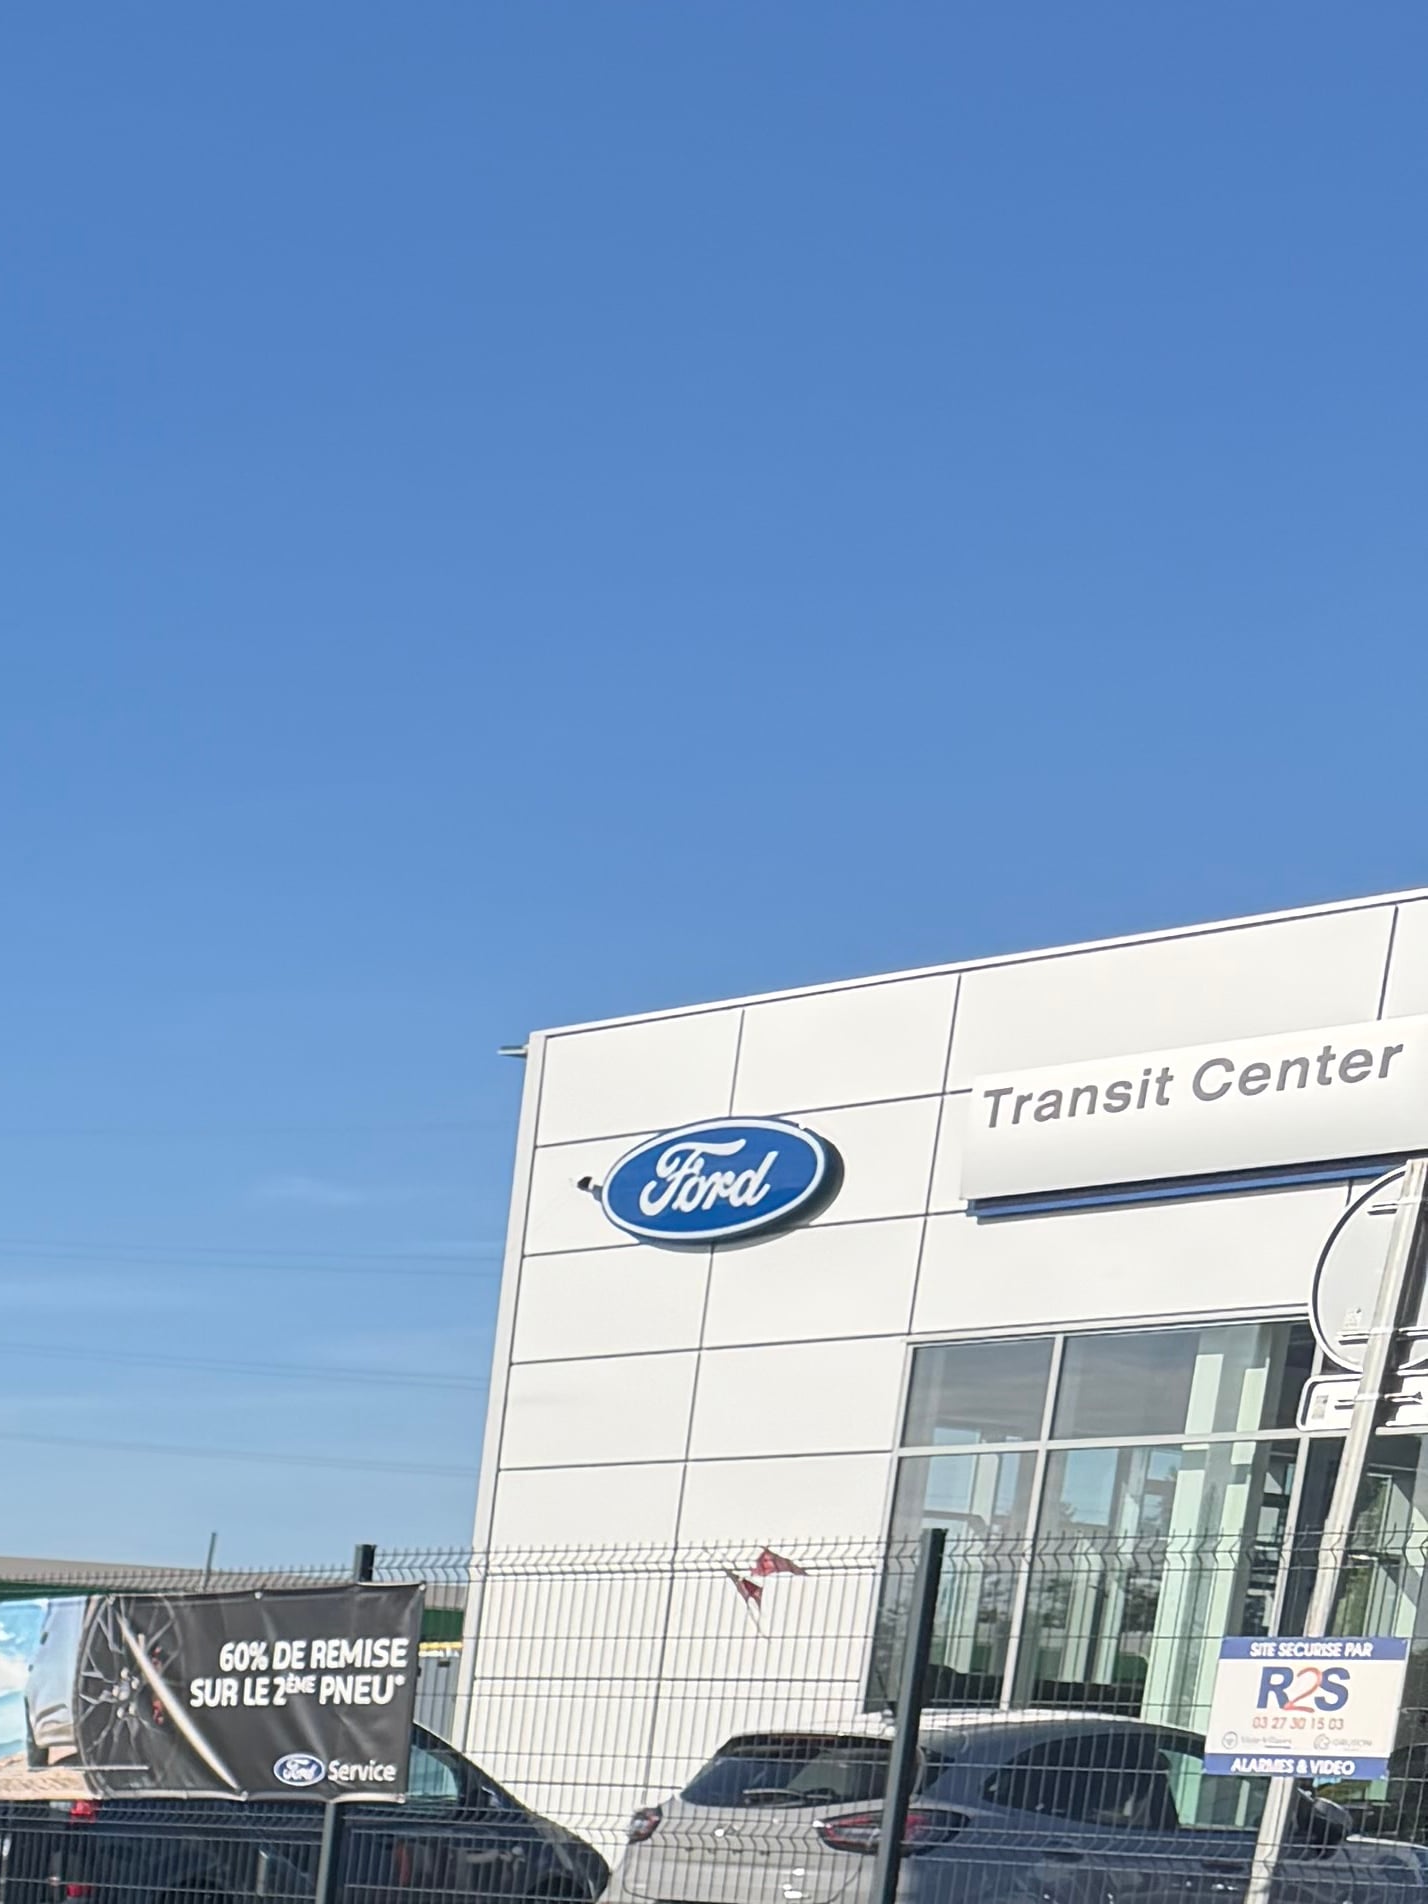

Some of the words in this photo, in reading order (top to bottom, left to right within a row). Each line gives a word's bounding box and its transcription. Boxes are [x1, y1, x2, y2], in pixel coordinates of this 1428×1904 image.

[984, 1067, 1173, 1128] Transit
[1192, 1044, 1404, 1101] Center
[639, 1138, 779, 1217] Ford
[219, 1639, 269, 1672] 60%
[272, 1639, 307, 1670] DE
[309, 1637, 410, 1669] REMISE
[1249, 1641, 1277, 1657] SITE
[1344, 1642, 1375, 1657] PAR
[190, 1677, 239, 1708] SUR
[243, 1676, 270, 1706] LE
[1256, 1666, 1351, 1713] R2S
[1252, 1716, 1269, 1730] 03
[1271, 1716, 1287, 1730] 27
[1310, 1717, 1325, 1730] 15
[281, 1758, 319, 1782] Ford
[327, 1759, 398, 1782] Service
[1230, 1758, 1295, 1774] ALARMES
[1296, 1760, 1309, 1774] &
[1309, 1760, 1357, 1775] VIDEO
